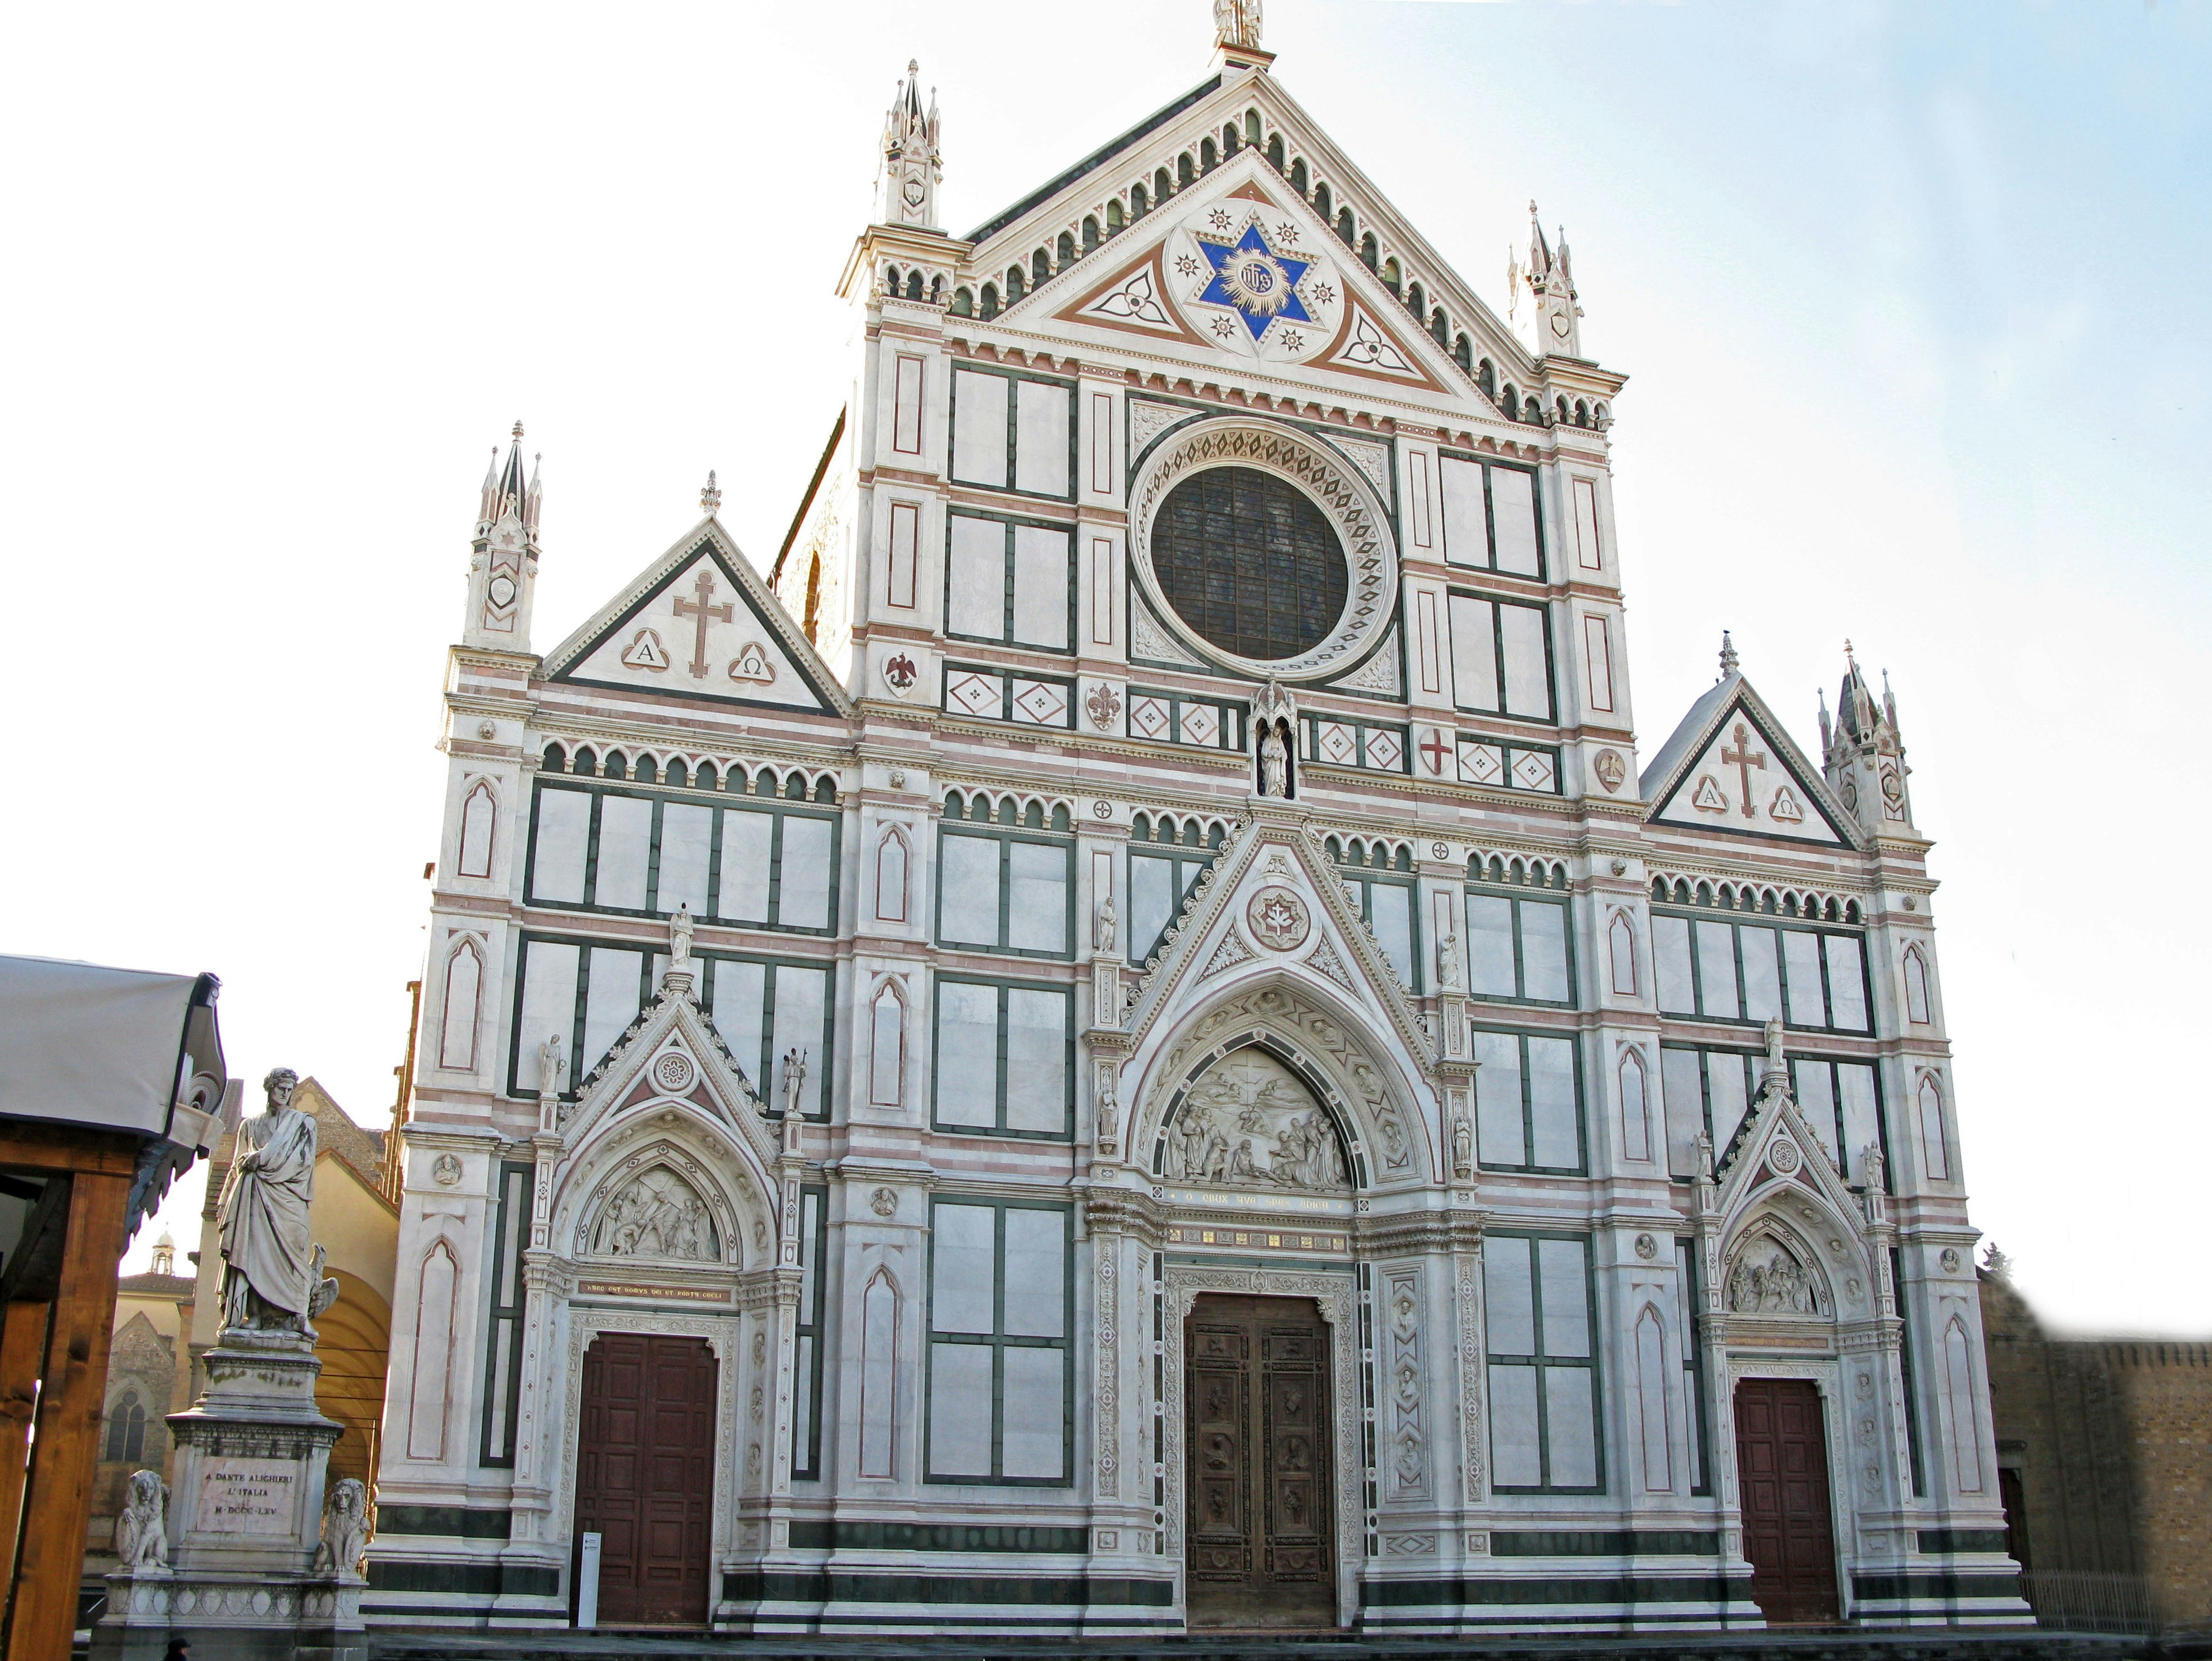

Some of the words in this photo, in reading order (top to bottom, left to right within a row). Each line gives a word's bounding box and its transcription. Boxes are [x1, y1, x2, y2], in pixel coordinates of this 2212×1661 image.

[743, 657, 762, 675] Ω
[1780, 799, 1793, 815] Ω
[216, 1473, 245, 1481] DANTE
[249, 1474, 293, 1483] ALIGHIERI
